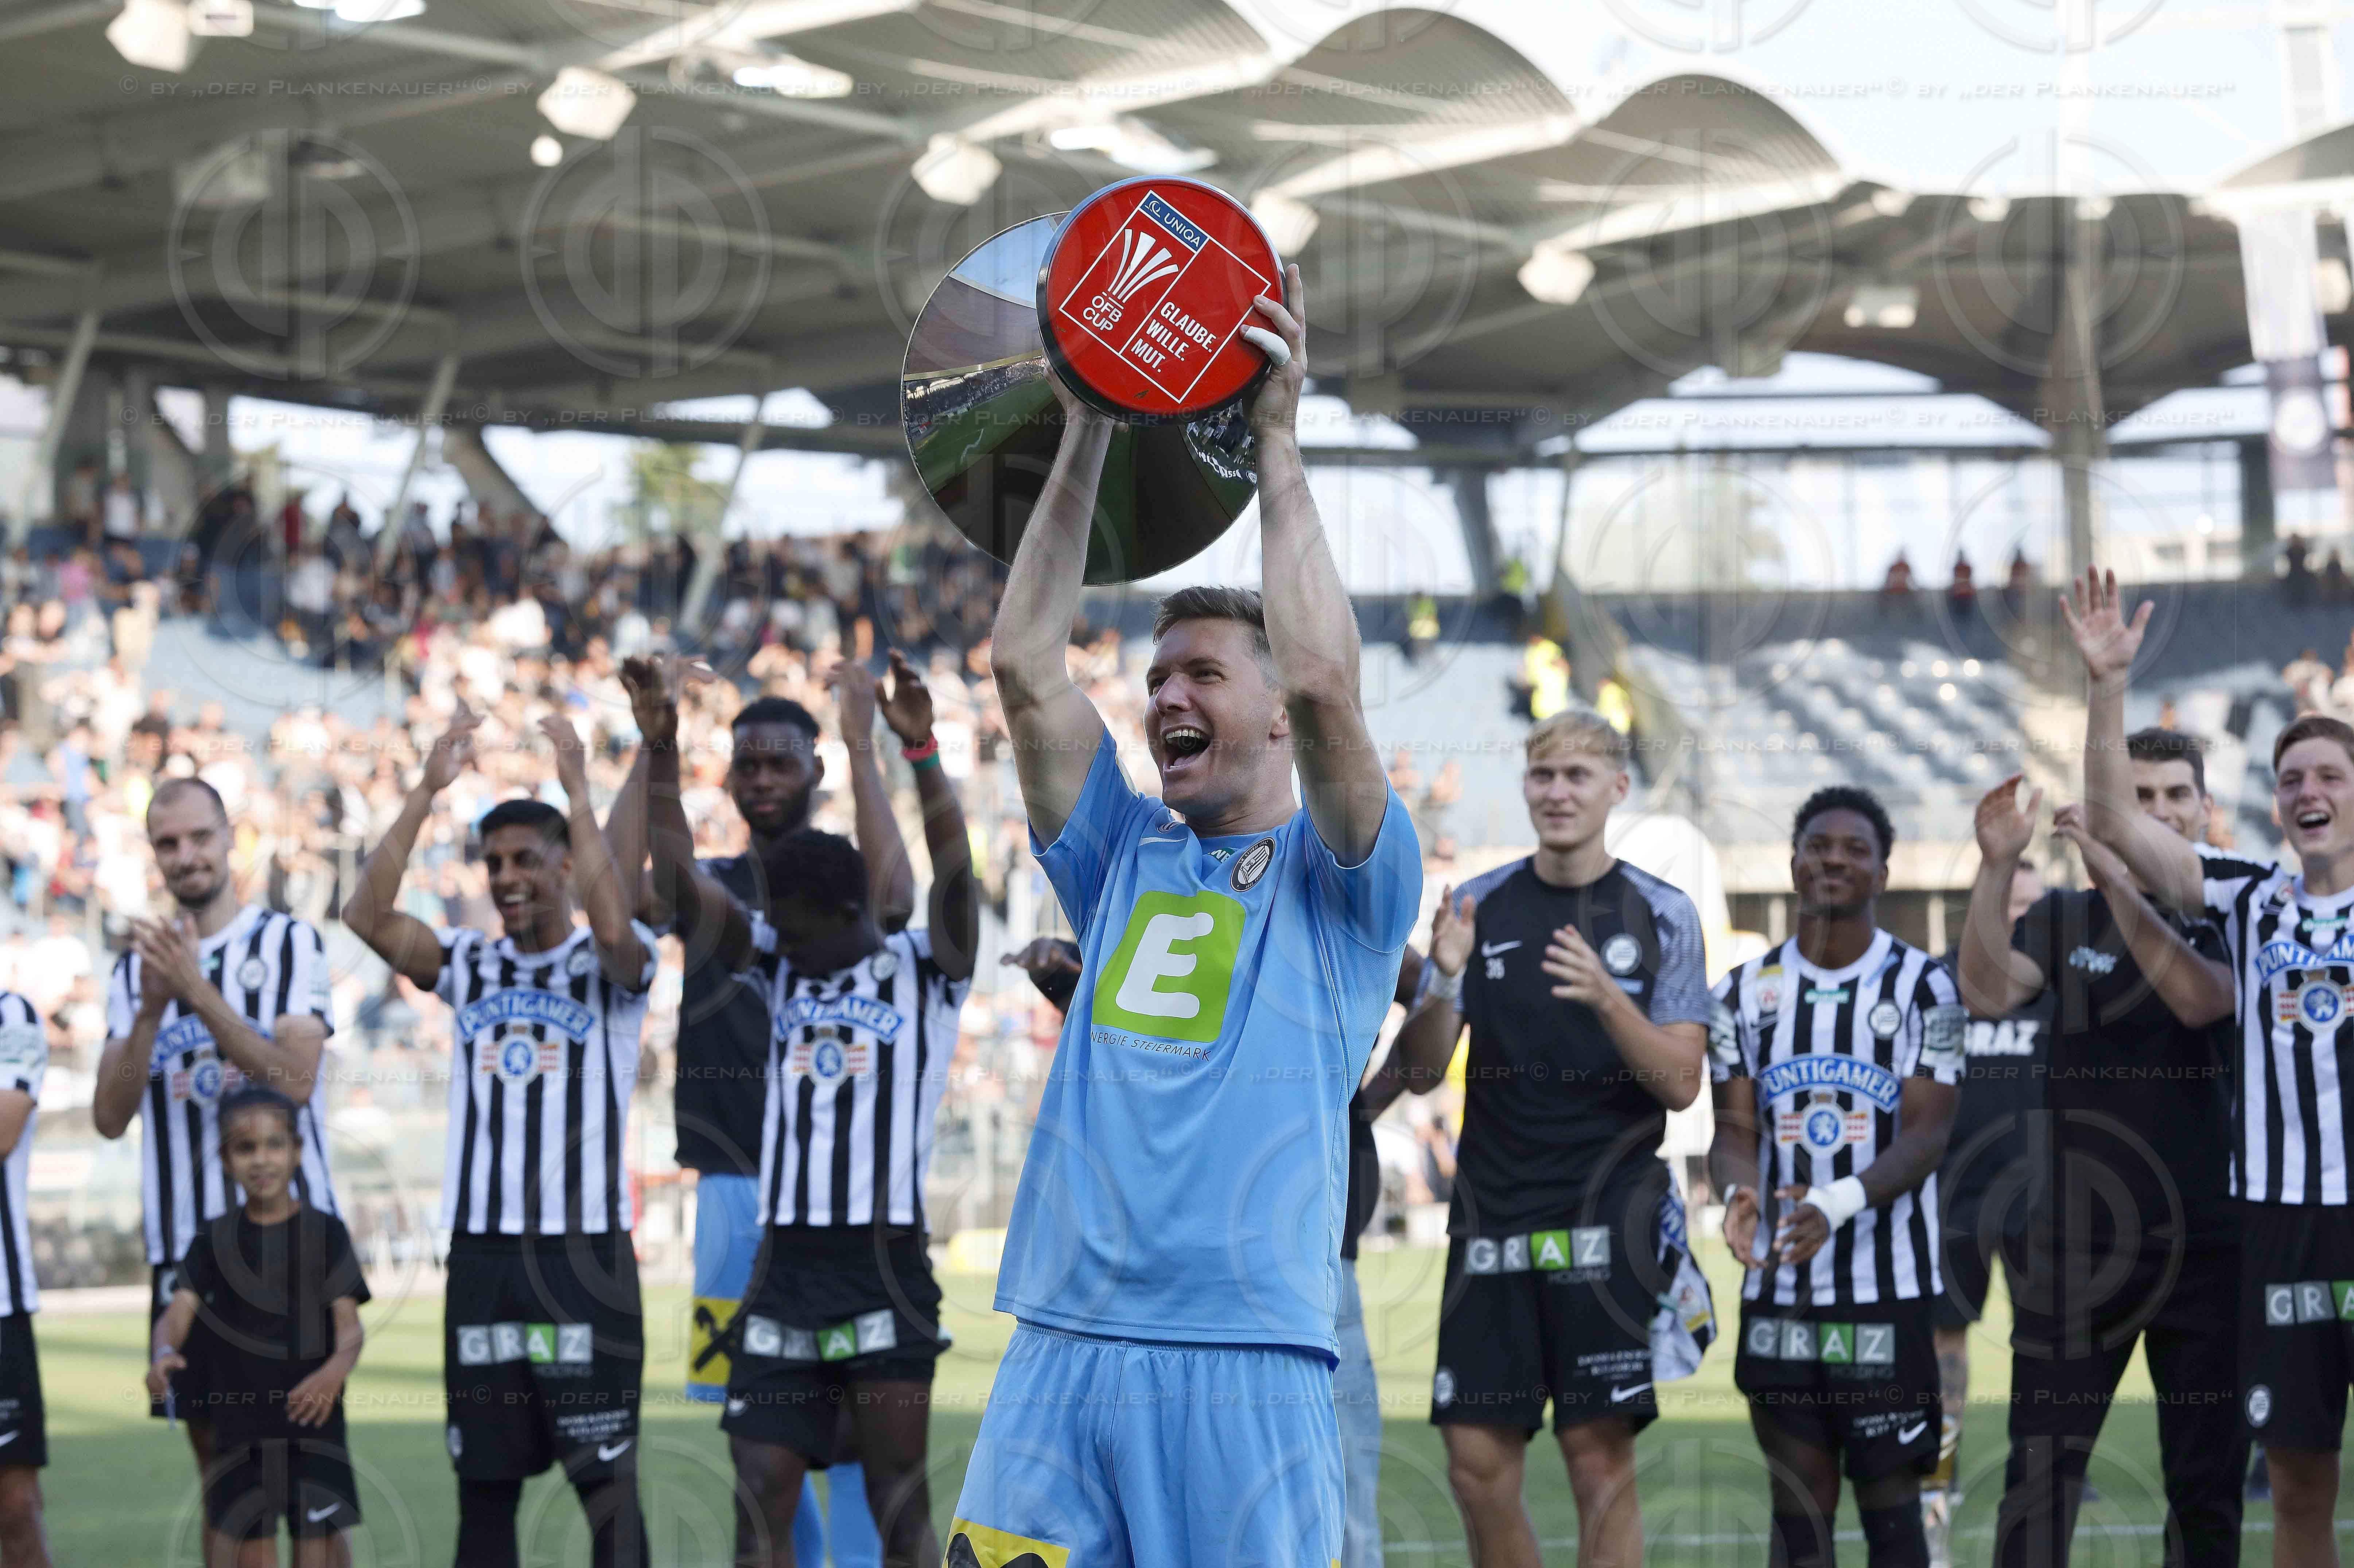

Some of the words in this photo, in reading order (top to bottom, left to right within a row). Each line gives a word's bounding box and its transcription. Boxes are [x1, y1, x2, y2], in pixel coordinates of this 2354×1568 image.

[1164, 212, 1200, 248] UNIQA
[1083, 307, 1114, 331] CUP
[1160, 301, 1217, 353] GLAUBE.
[1131, 338, 1166, 373] MUT.
[1146, 318, 1189, 361] WILLE.
[1115, 912, 1215, 1019] E
[1131, 1039, 1211, 1062] STEIERMARK
[1468, 1228, 1604, 1272] GRAZ
[460, 1326, 591, 1363] GRAZ
[1749, 1321, 1888, 1361] GRAZ
